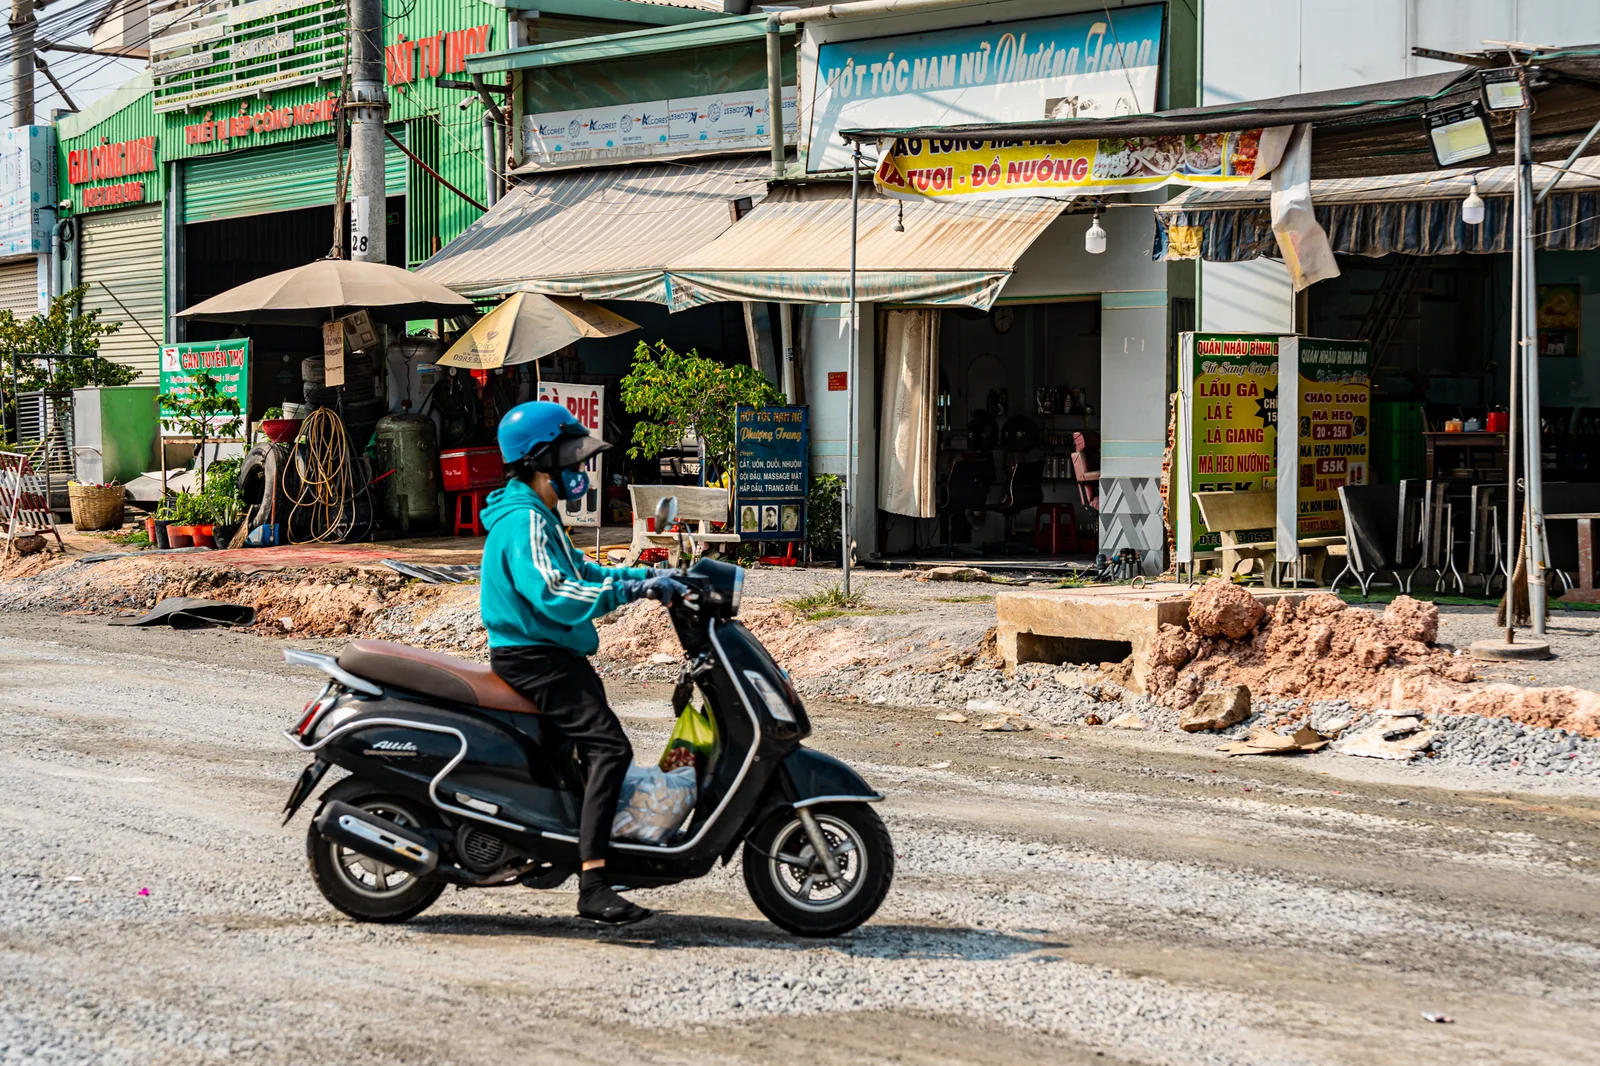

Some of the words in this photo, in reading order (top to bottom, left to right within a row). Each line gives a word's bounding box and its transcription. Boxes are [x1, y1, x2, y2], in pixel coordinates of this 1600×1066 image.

[385, 33, 415, 94] VẬT
[418, 30, 443, 79] TƯ
[445, 24, 489, 75] INOX
[827, 58, 867, 98] HỚT
[870, 52, 909, 95] TÓC
[912, 54, 957, 90] NAM
[959, 41, 991, 85] NỮ
[993, 32, 1080, 101] Phượng
[1084, 22, 1153, 87] Trang
[185, 111, 215, 145] THIẾT
[217, 119, 228, 144] BỊ
[229, 102, 251, 137] BẾP
[252, 104, 291, 133] CÔNG
[293, 91, 339, 127] NGHIỆ
[68, 148, 90, 185] GIA
[91, 136, 124, 180] CÔNG
[125, 136, 156, 176] INOX
[971, 155, 1002, 187] ĐỒ
[1006, 155, 1089, 184] NƯỚNG
[1197, 338, 1222, 357] QUÁN
[1222, 338, 1249, 358] NHẬU
[1249, 339, 1272, 356] BÌNH
[1301, 346, 1320, 364] QUÁN
[1352, 348, 1368, 364] DÂN
[181, 347, 200, 369] CẦN
[200, 344, 228, 369] TUYỂN
[228, 346, 245, 370] THỢ
[1218, 361, 1247, 377] Sang
[1200, 377, 1231, 397] LẨU
[1236, 380, 1259, 397] GÀ
[1304, 390, 1333, 404] CHÁO
[1335, 390, 1368, 404] LÒNG
[566, 390, 599, 430] PHÊ
[1225, 402, 1233, 420] É
[1312, 408, 1329, 421] MÁ
[1331, 410, 1354, 422] HEO
[775, 427, 802, 442] Trang
[1225, 428, 1264, 444] GIANG
[1316, 426, 1326, 438] 20
[1332, 425, 1348, 438] 25K
[1299, 441, 1312, 457] MÁ
[1314, 444, 1331, 457] HEO
[1333, 441, 1367, 457] NƯỚNG
[1198, 451, 1214, 474] MÁ
[1216, 454, 1234, 474] HEO
[1237, 451, 1270, 474] NƯỚNG
[1321, 460, 1345, 473] 55K
[764, 472, 790, 480] MASSAGE
[765, 484, 784, 492] TRANG
[1315, 478, 1328, 492] BIA
[372, 740, 418, 751] Attila
